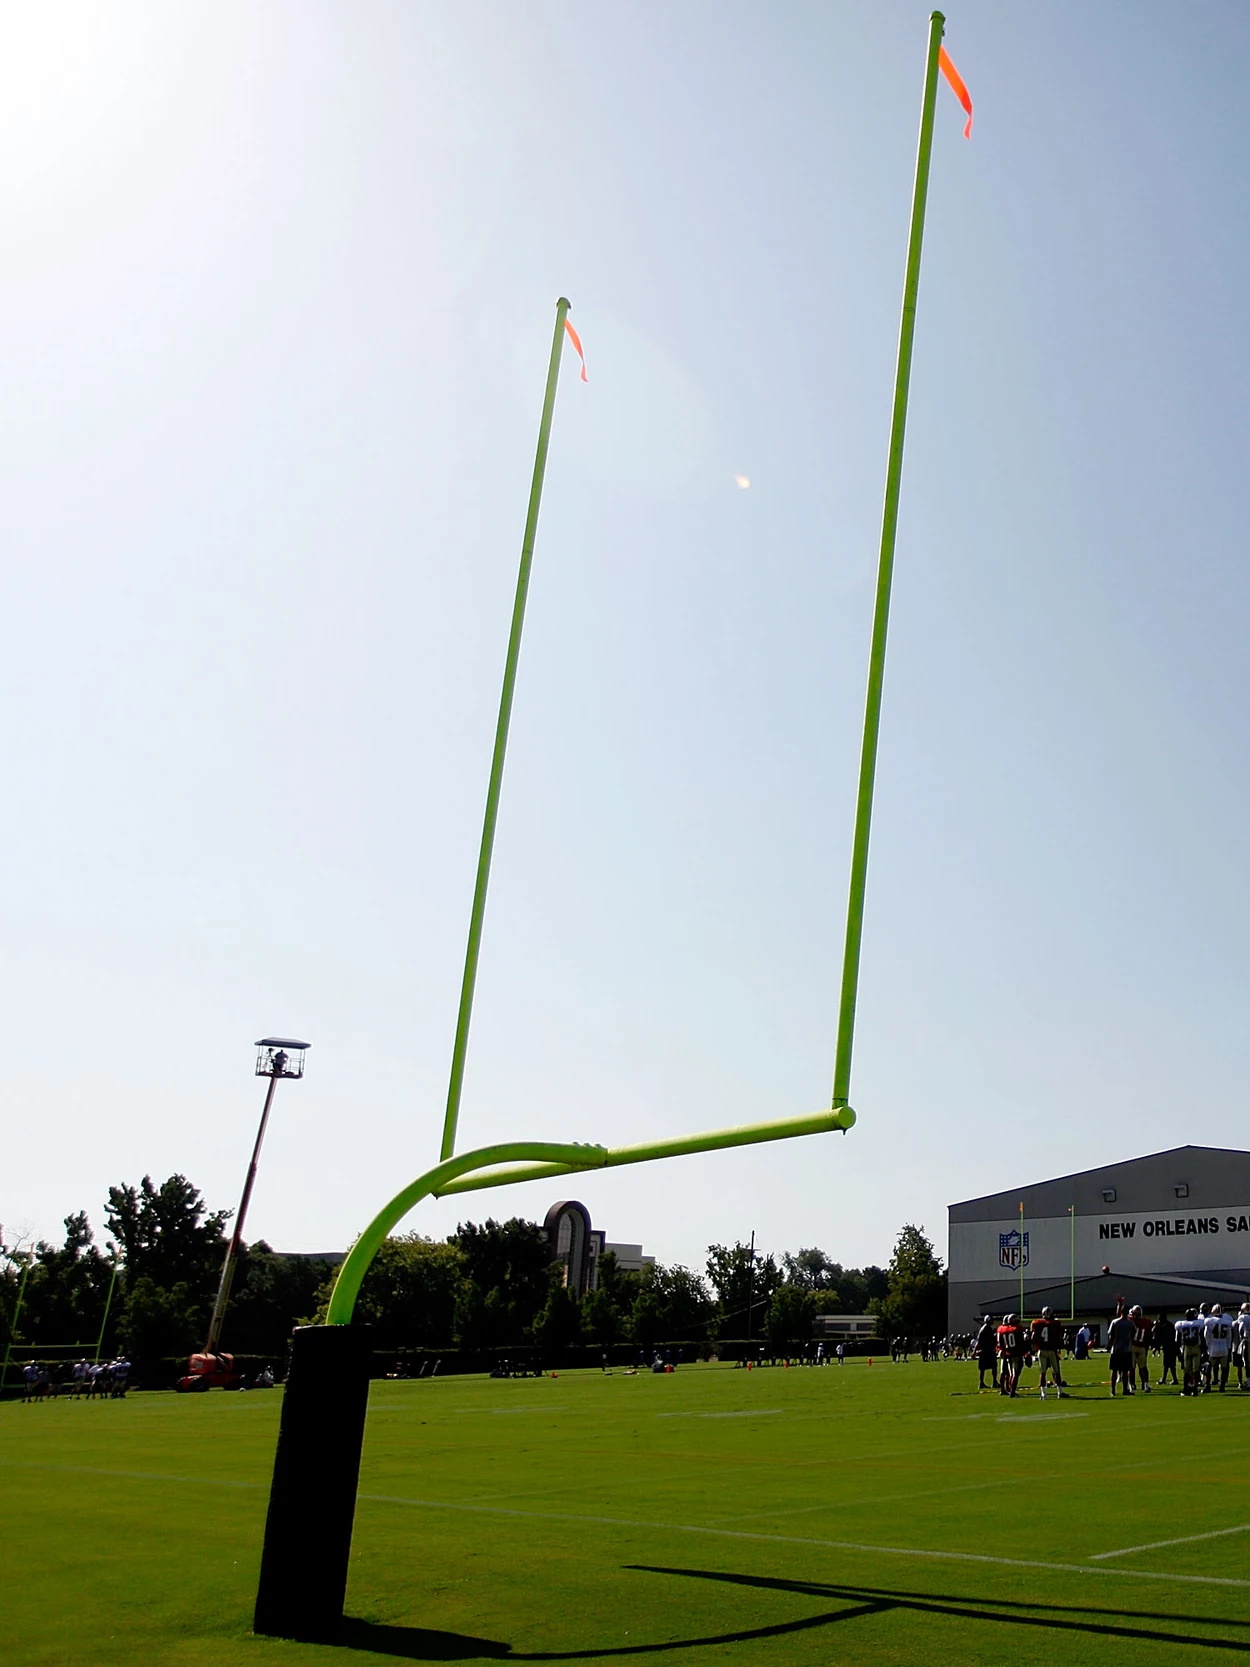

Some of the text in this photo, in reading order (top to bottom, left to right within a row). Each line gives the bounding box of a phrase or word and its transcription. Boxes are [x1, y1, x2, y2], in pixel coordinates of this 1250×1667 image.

[1099, 1222, 1136, 1239] NEW
[1143, 1217, 1219, 1237] ORLEANS
[1001, 1246, 1027, 1267] NFL
[1041, 1326, 1049, 1342] 4
[1212, 1323, 1228, 1338] 45
[1002, 1332, 1016, 1348] 10
